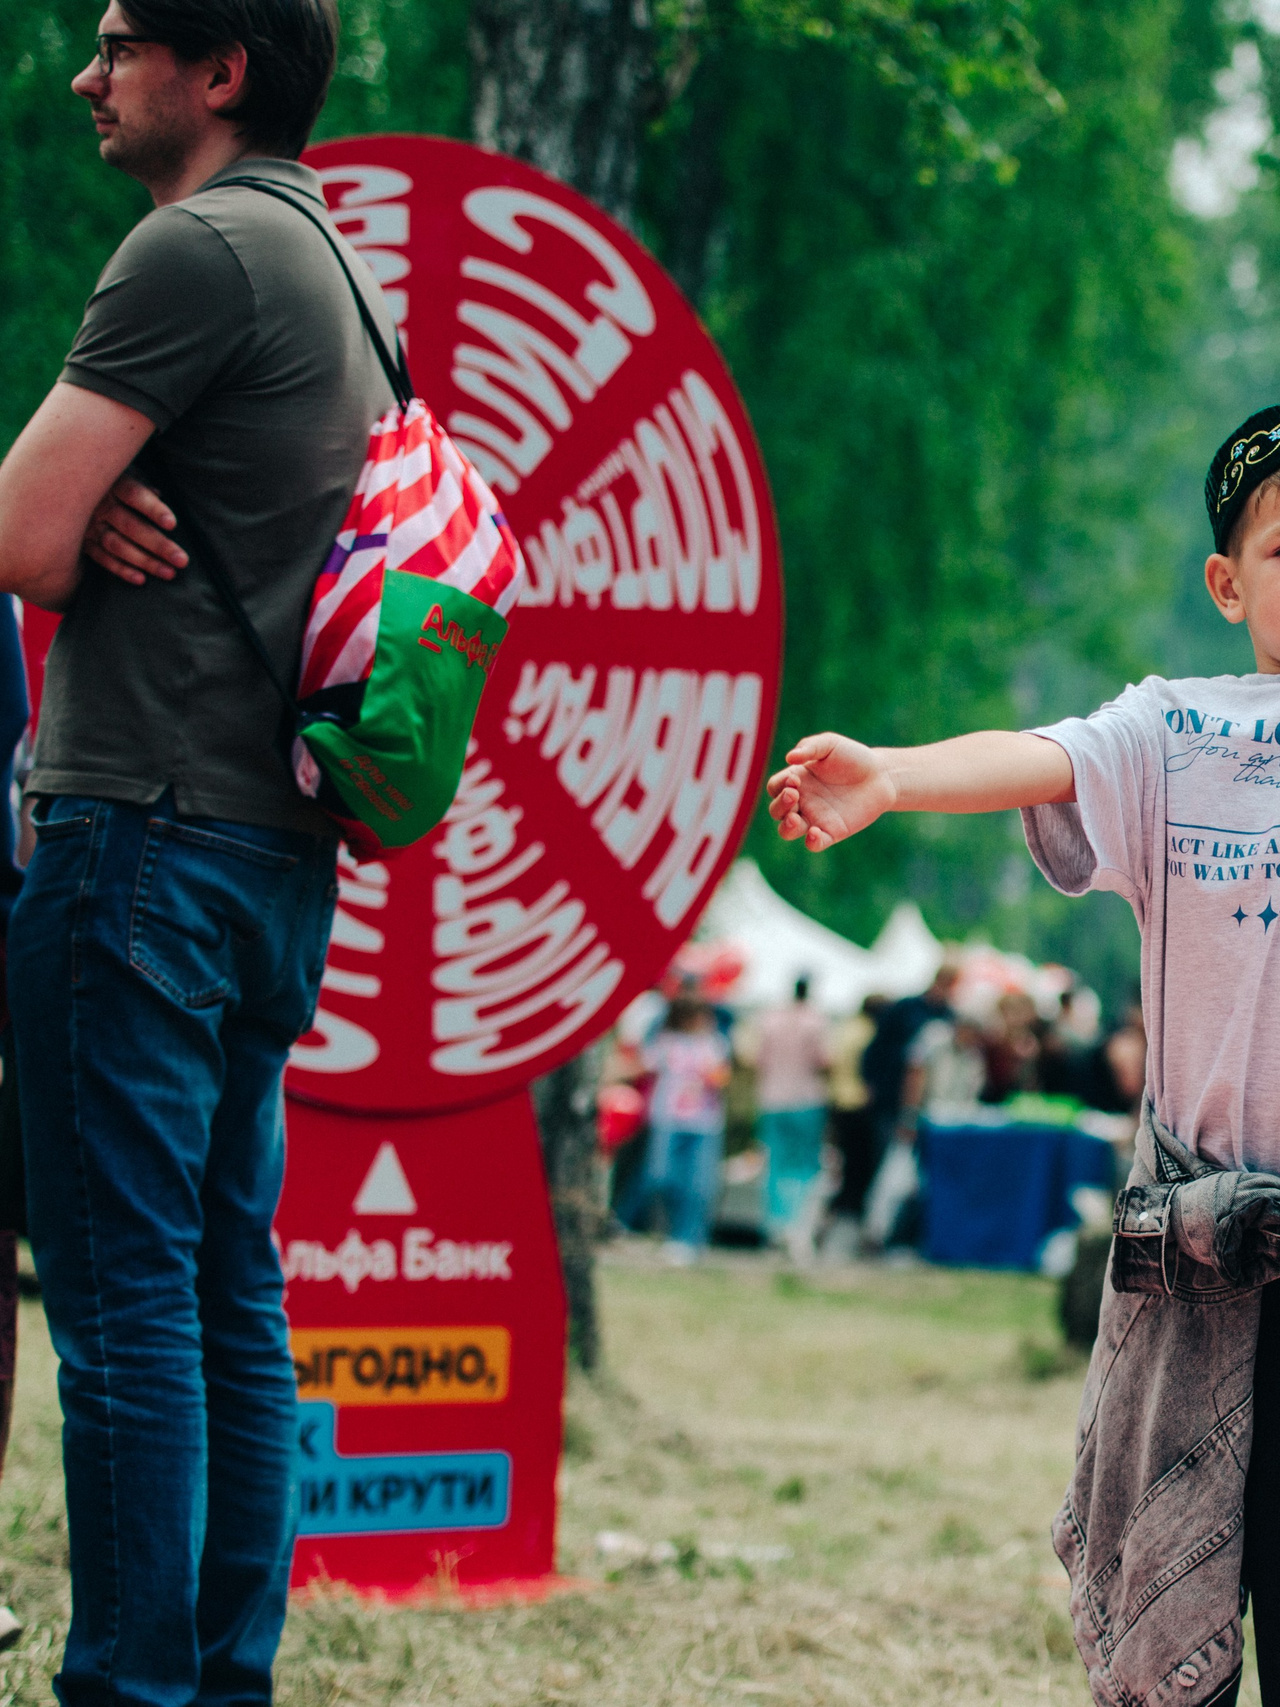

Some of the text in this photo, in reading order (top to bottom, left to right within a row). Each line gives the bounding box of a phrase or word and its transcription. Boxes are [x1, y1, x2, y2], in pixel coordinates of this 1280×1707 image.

[1161, 708, 1240, 737] ON'T
[1165, 730, 1240, 773] You
[504, 661, 763, 930] ВЫБИРАЙ
[1171, 836, 1204, 855] ACT
[1212, 841, 1260, 859] LIKE
[1265, 838, 1279, 854] A
[1194, 863, 1254, 881] WANT
[430, 738, 626, 1076] СПОРТФИ
[274, 1226, 513, 1294] льфа Банк
[294, 1345, 497, 1398] ЫГОДНО,
[301, 1470, 496, 1518] И КРУТИ
